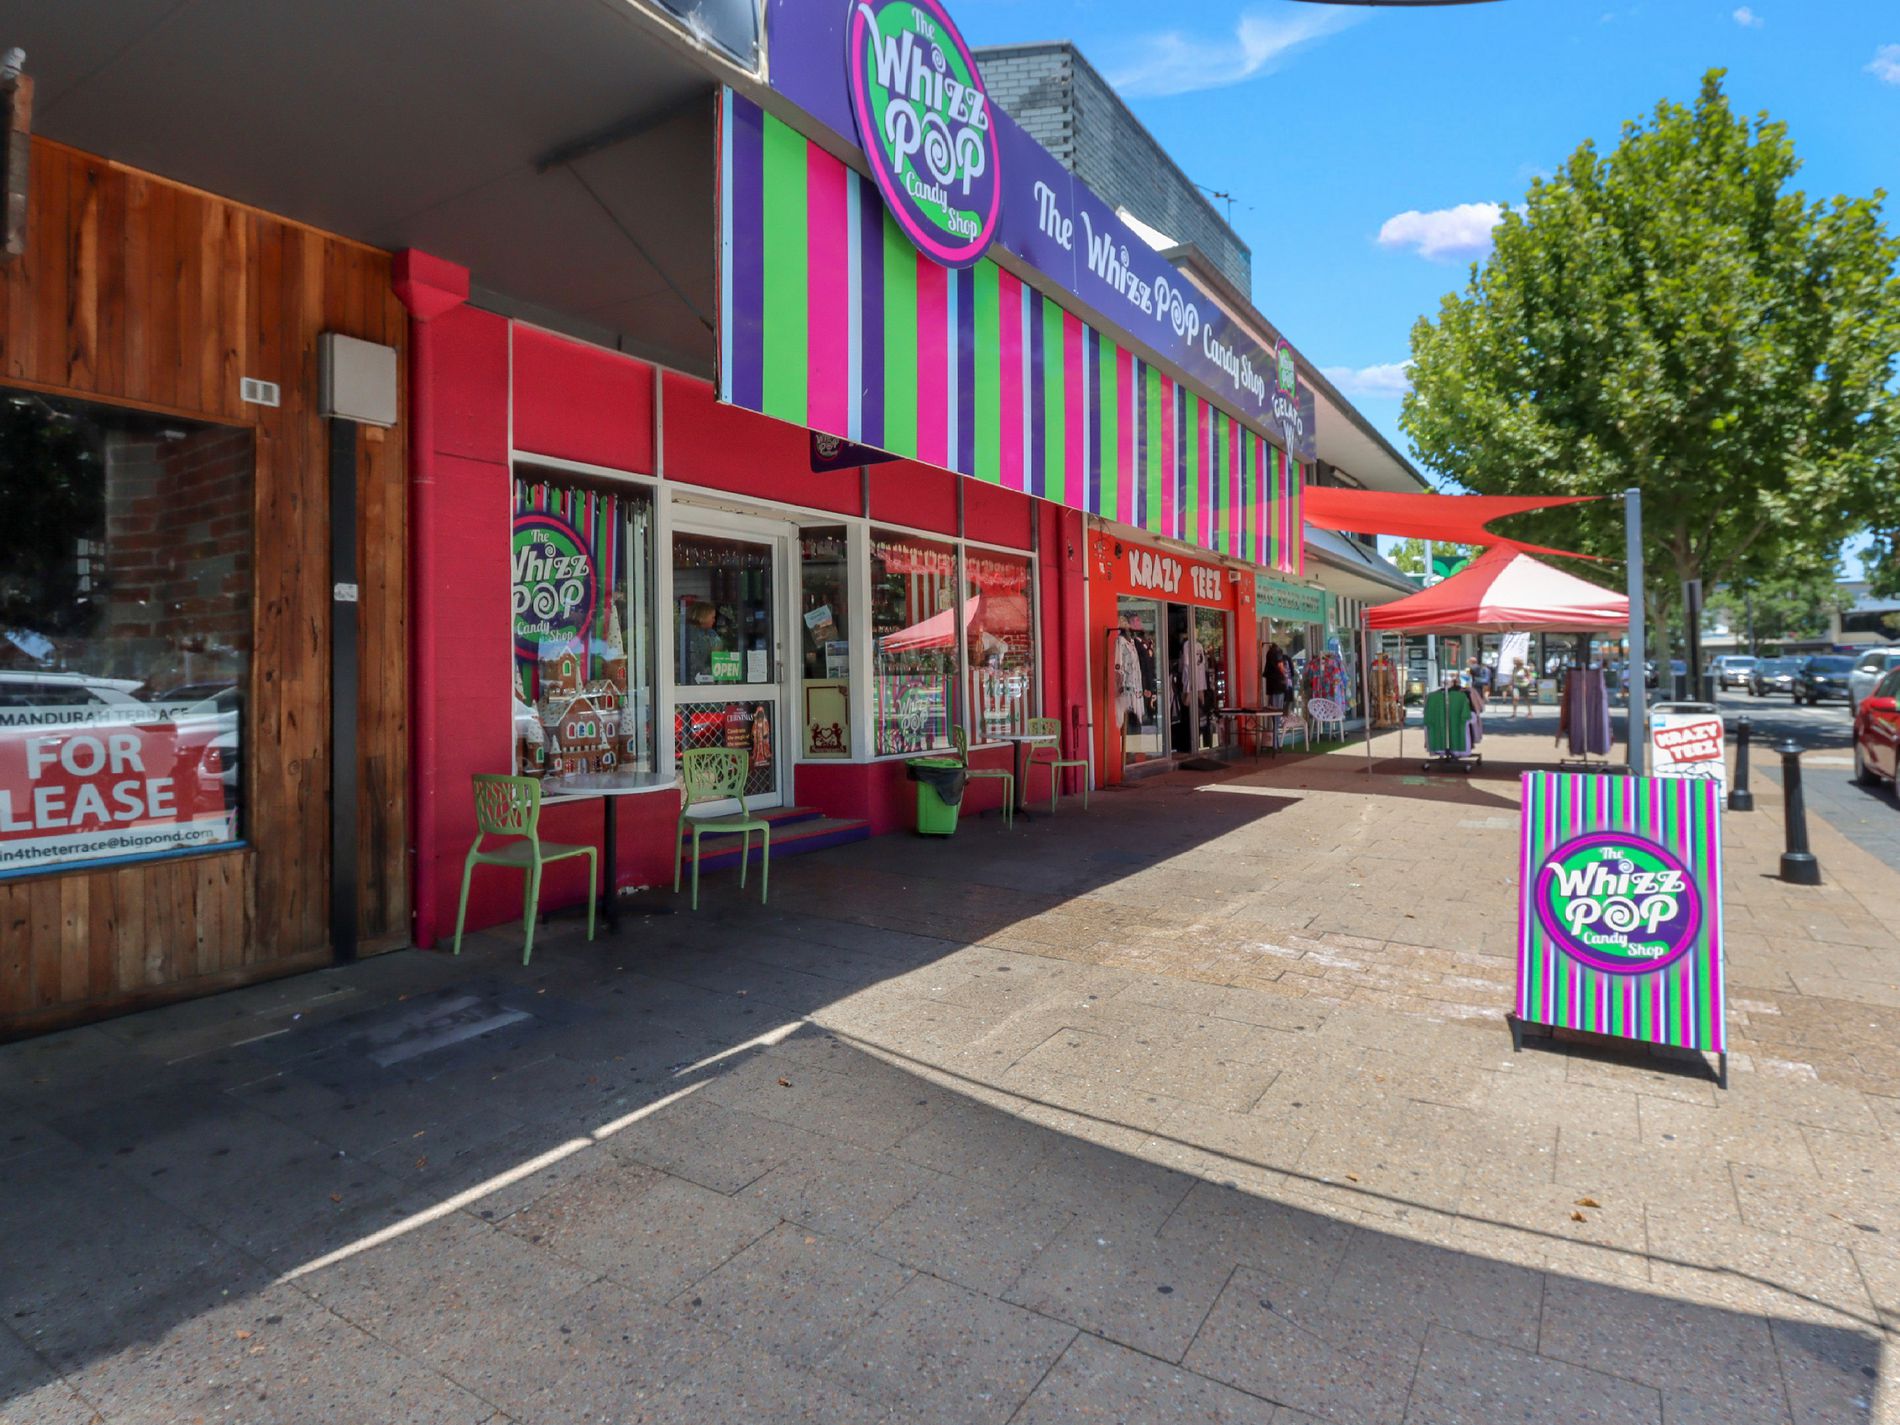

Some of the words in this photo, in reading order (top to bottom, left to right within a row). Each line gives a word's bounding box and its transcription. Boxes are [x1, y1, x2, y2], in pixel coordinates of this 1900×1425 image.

[911, 8, 936, 41] The
[856, 2, 989, 131] Whizz
[905, 170, 948, 214] Candy
[947, 207, 978, 243] Shop
[1033, 181, 1074, 251] The
[1080, 210, 1152, 316] Whizz
[1203, 328, 1240, 389] Candy
[1240, 355, 1266, 407] Shop
[1274, 397, 1303, 435] GELATO
[530, 529, 549, 543] The
[1128, 550, 1182, 594] KRAZY
[1191, 566, 1221, 599] TEEZ
[517, 620, 550, 637] Candy
[549, 628, 574, 643] Shop
[714, 662, 740, 677] OPEN
[1655, 722, 1718, 748] KRAZY
[26, 734, 145, 779] FOR
[0, 777, 178, 832] LEASE
[1600, 847, 1624, 860] The
[1546, 859, 1686, 897] Whizz
[1584, 931, 1628, 950] Candy
[1628, 941, 1665, 960] Shop
